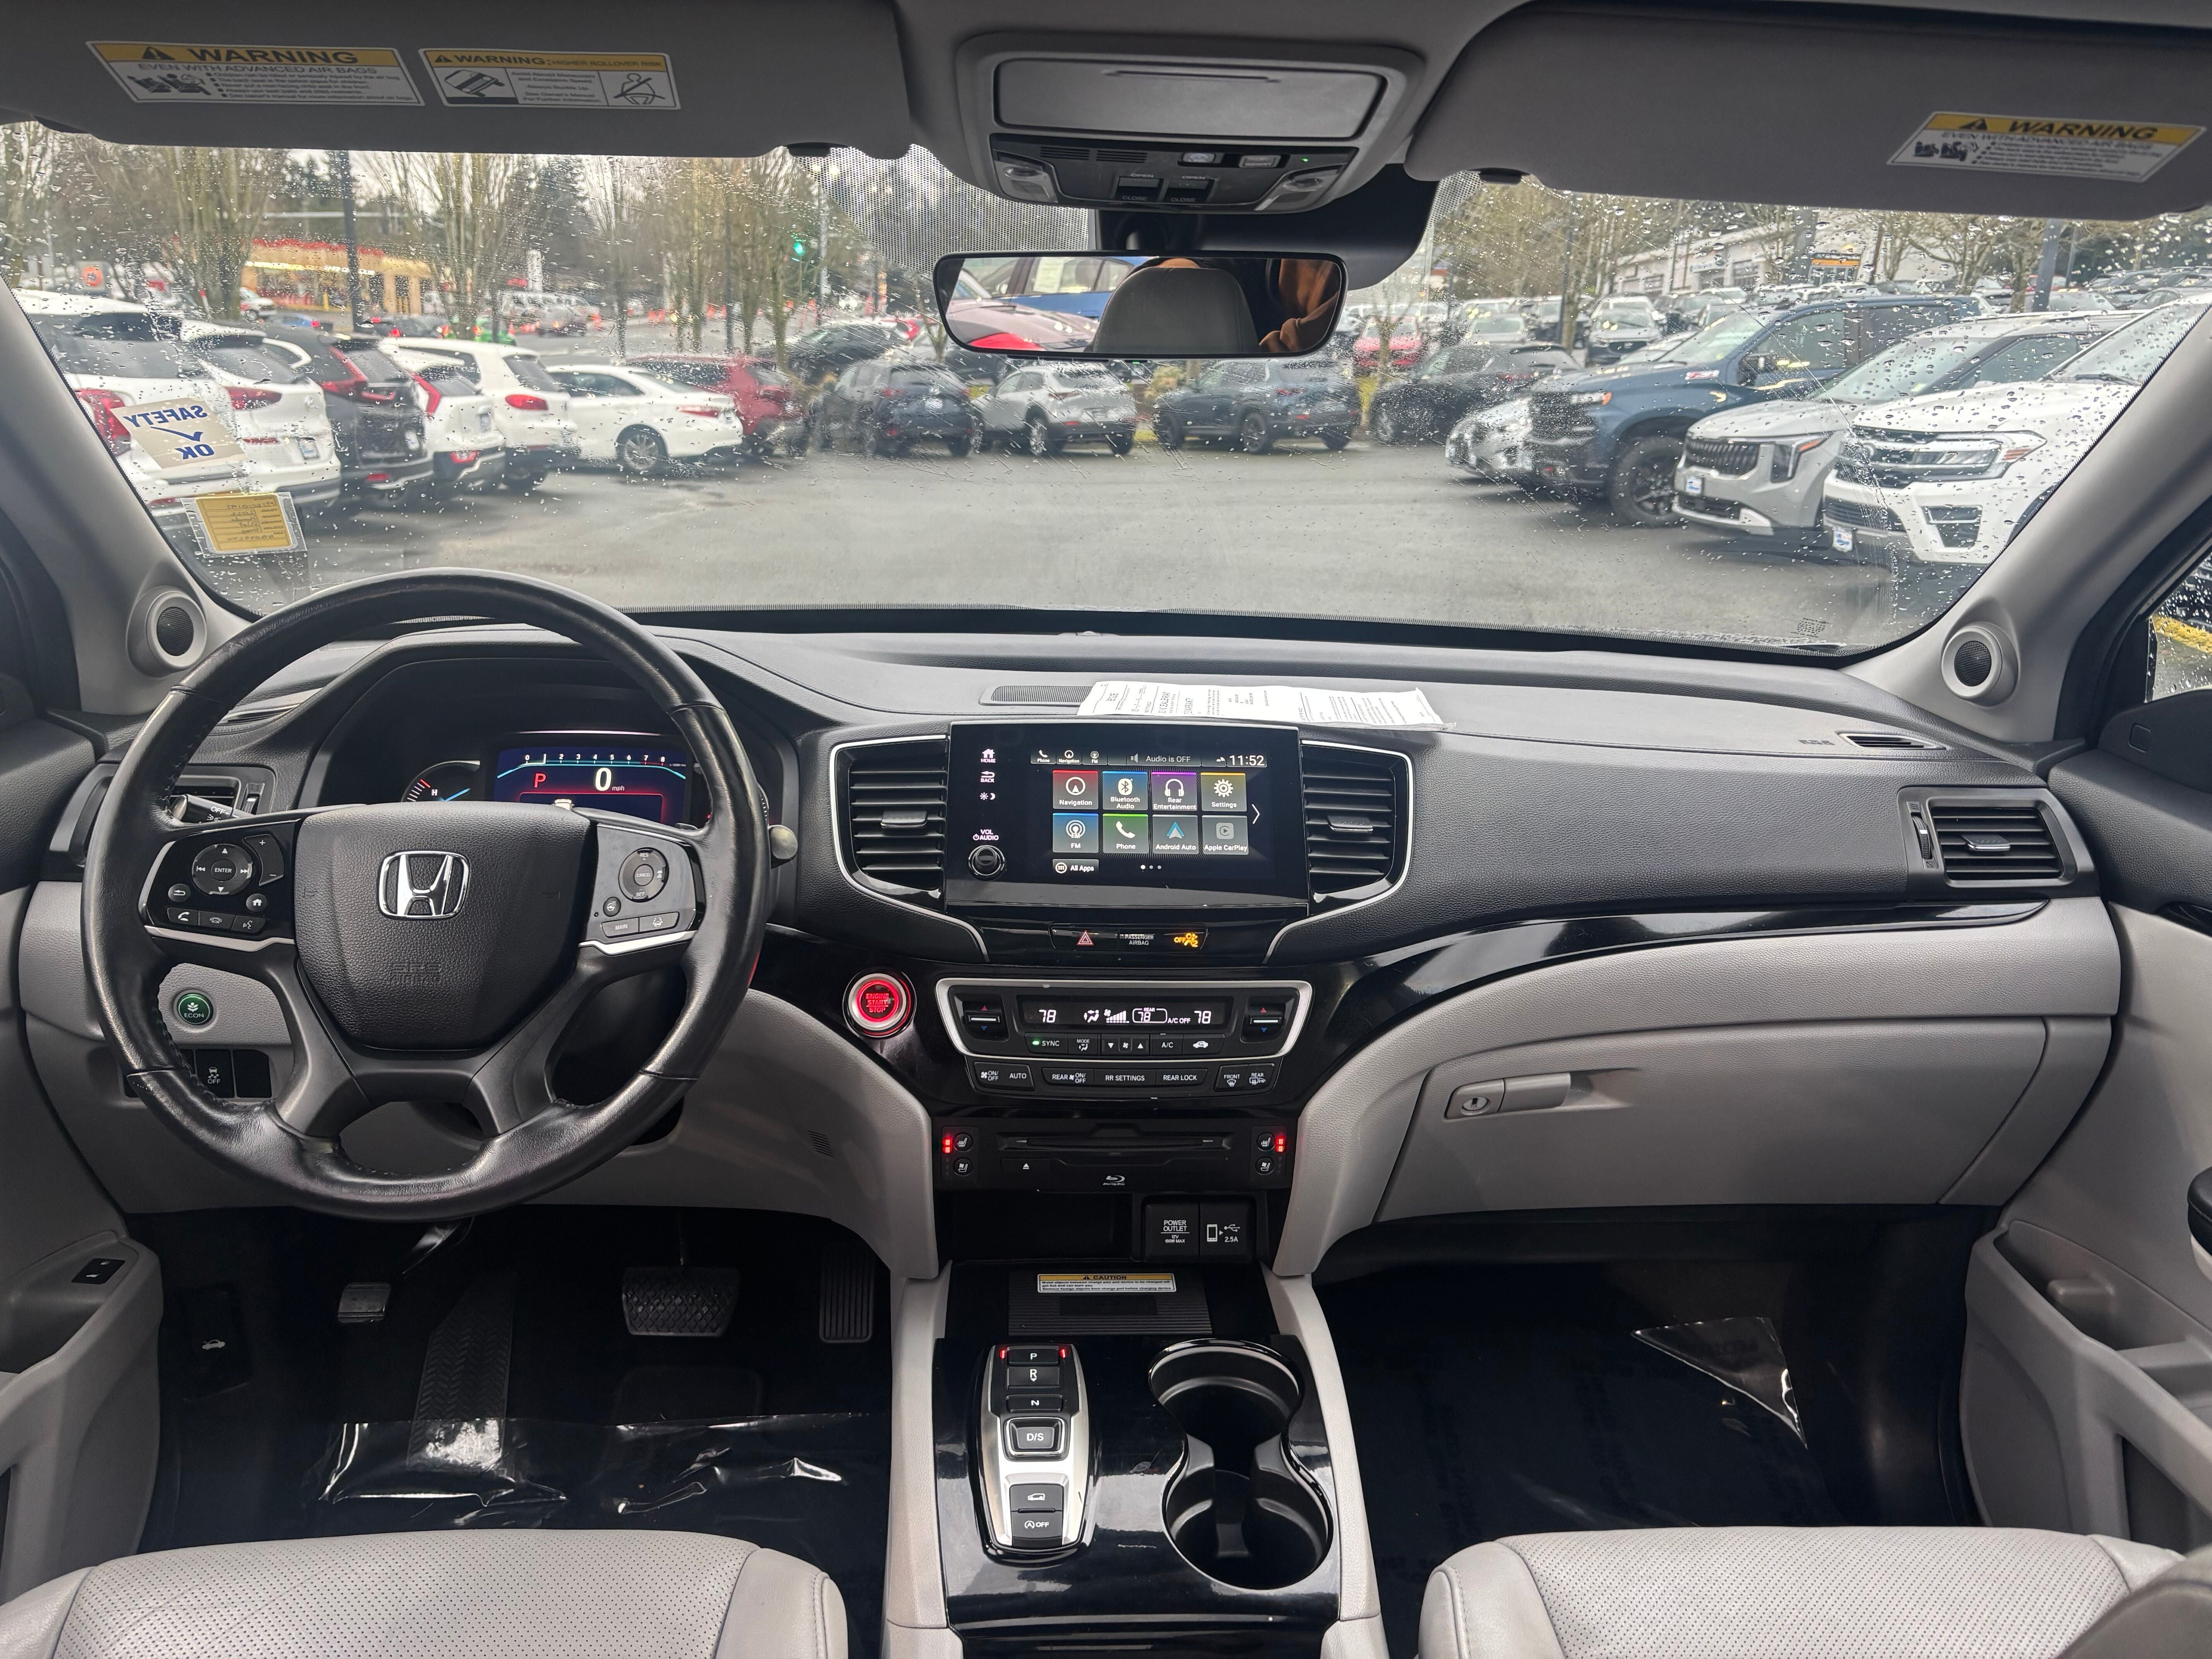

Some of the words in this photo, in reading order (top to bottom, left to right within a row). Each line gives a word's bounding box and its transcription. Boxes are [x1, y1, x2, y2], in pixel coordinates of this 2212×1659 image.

[188, 49, 358, 64] WARNING
[226, 65, 305, 73] ADVANCED
[2009, 121, 2158, 138] WARNING
[1230, 755, 1265, 766] 11:52
[534, 773, 546, 788] P
[595, 767, 612, 791] 0
[211, 806, 226, 815] OFF
[1039, 1010, 1056, 1023] 78
[1137, 1012, 1151, 1022] 78
[1194, 1010, 1211, 1024] 78
[1030, 1369, 1037, 1378] R
[1027, 1433, 1044, 1441] D/S
